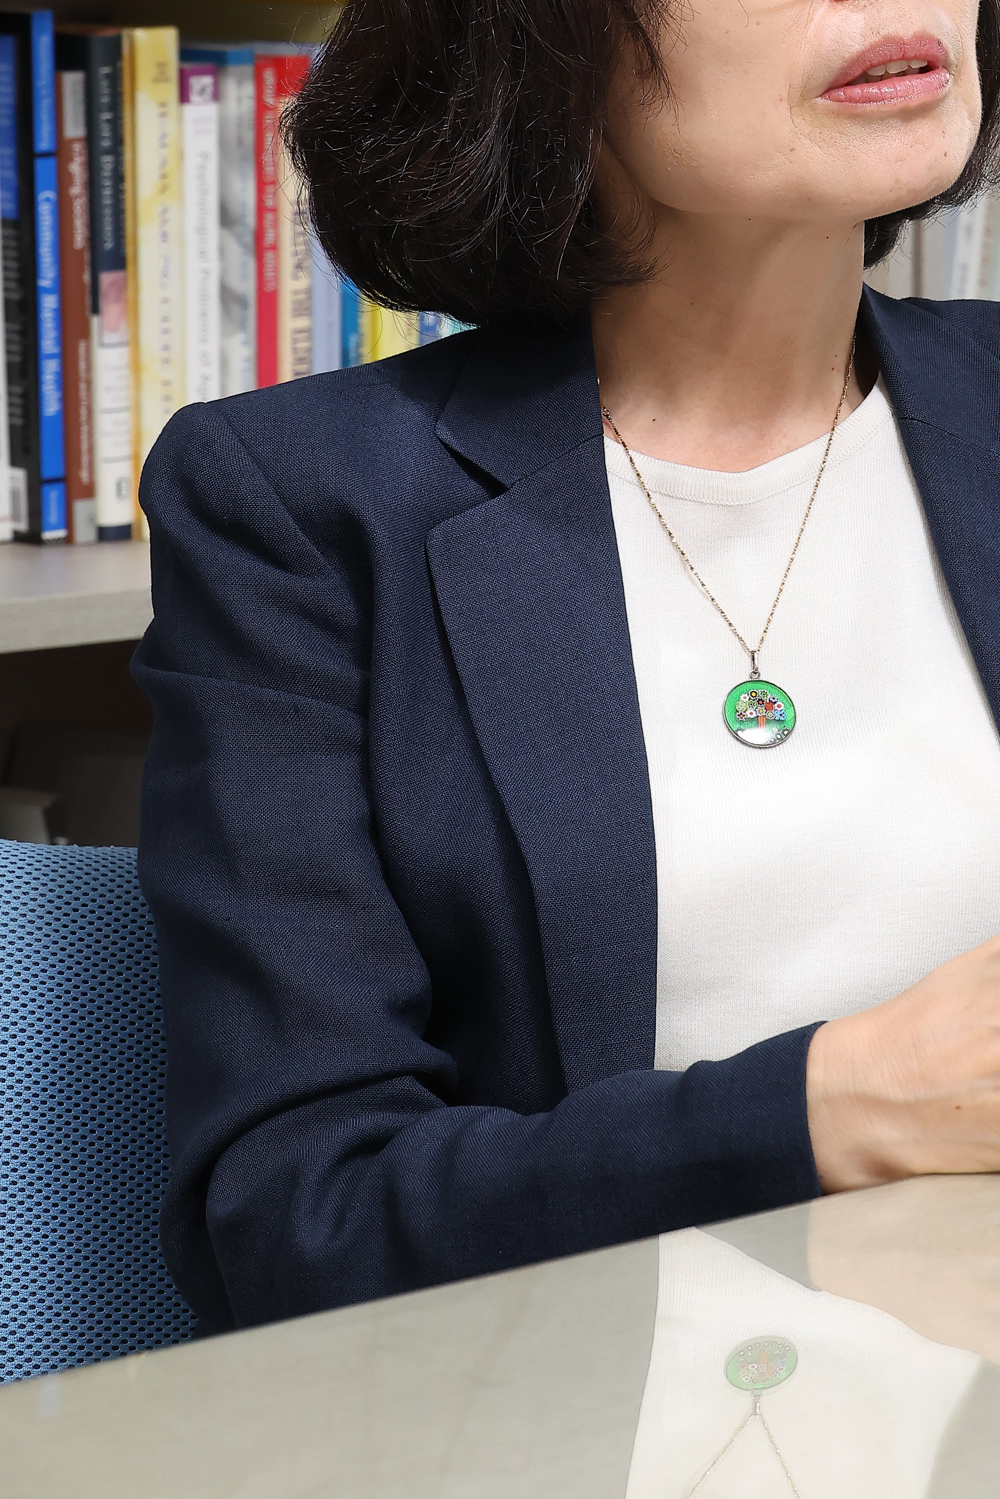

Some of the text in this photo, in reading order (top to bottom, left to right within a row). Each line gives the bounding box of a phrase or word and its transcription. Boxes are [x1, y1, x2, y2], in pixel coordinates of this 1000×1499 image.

[196, 152, 212, 263] Psychological
[38, 190, 62, 416] Community Mental Health
[198, 268, 213, 346] Problems
